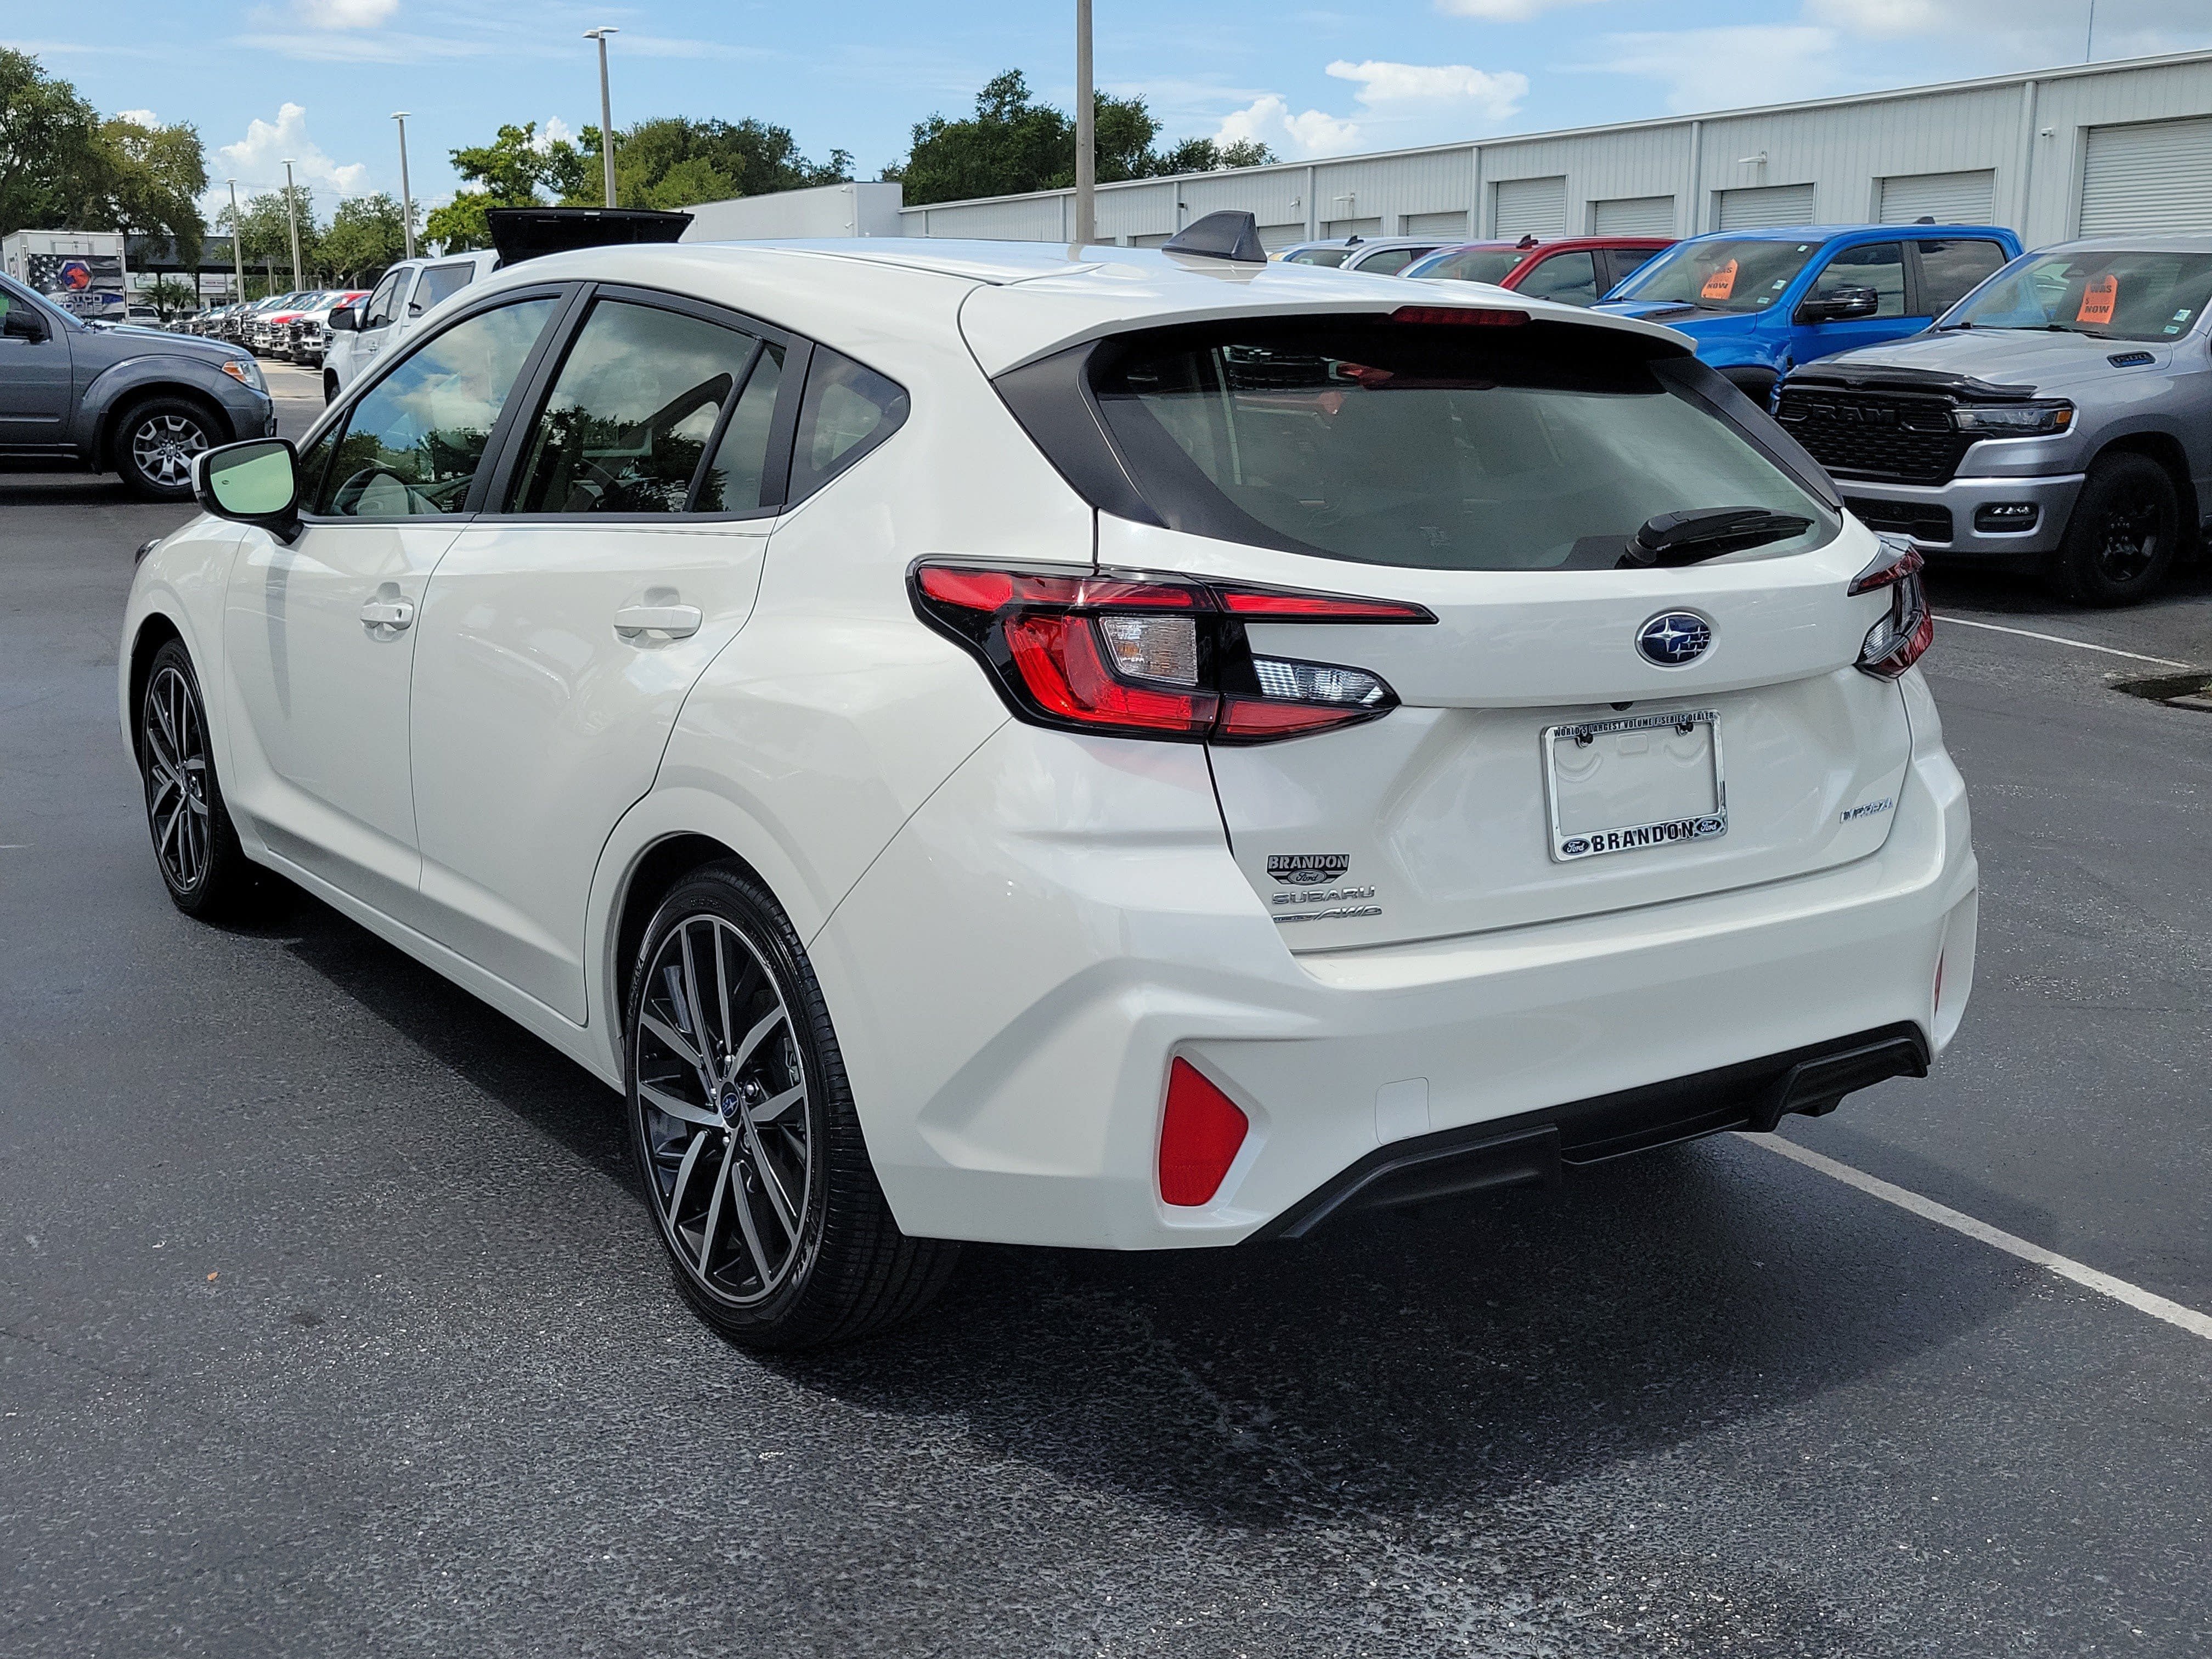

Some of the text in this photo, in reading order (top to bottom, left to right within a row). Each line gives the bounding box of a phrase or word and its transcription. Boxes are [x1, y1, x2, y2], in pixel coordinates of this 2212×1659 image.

[1812, 404, 1897, 424] RAM
[1554, 712, 1714, 737] WORLD'S LARGEST VOLUME F-SERIES DEALER
[1591, 821, 1696, 853] BRANDON
[1268, 855, 1348, 869] BRANDON
[1296, 872, 1319, 882] Ford
[1272, 885, 1375, 905] SUBARU
[1313, 905, 1383, 921] AWD
